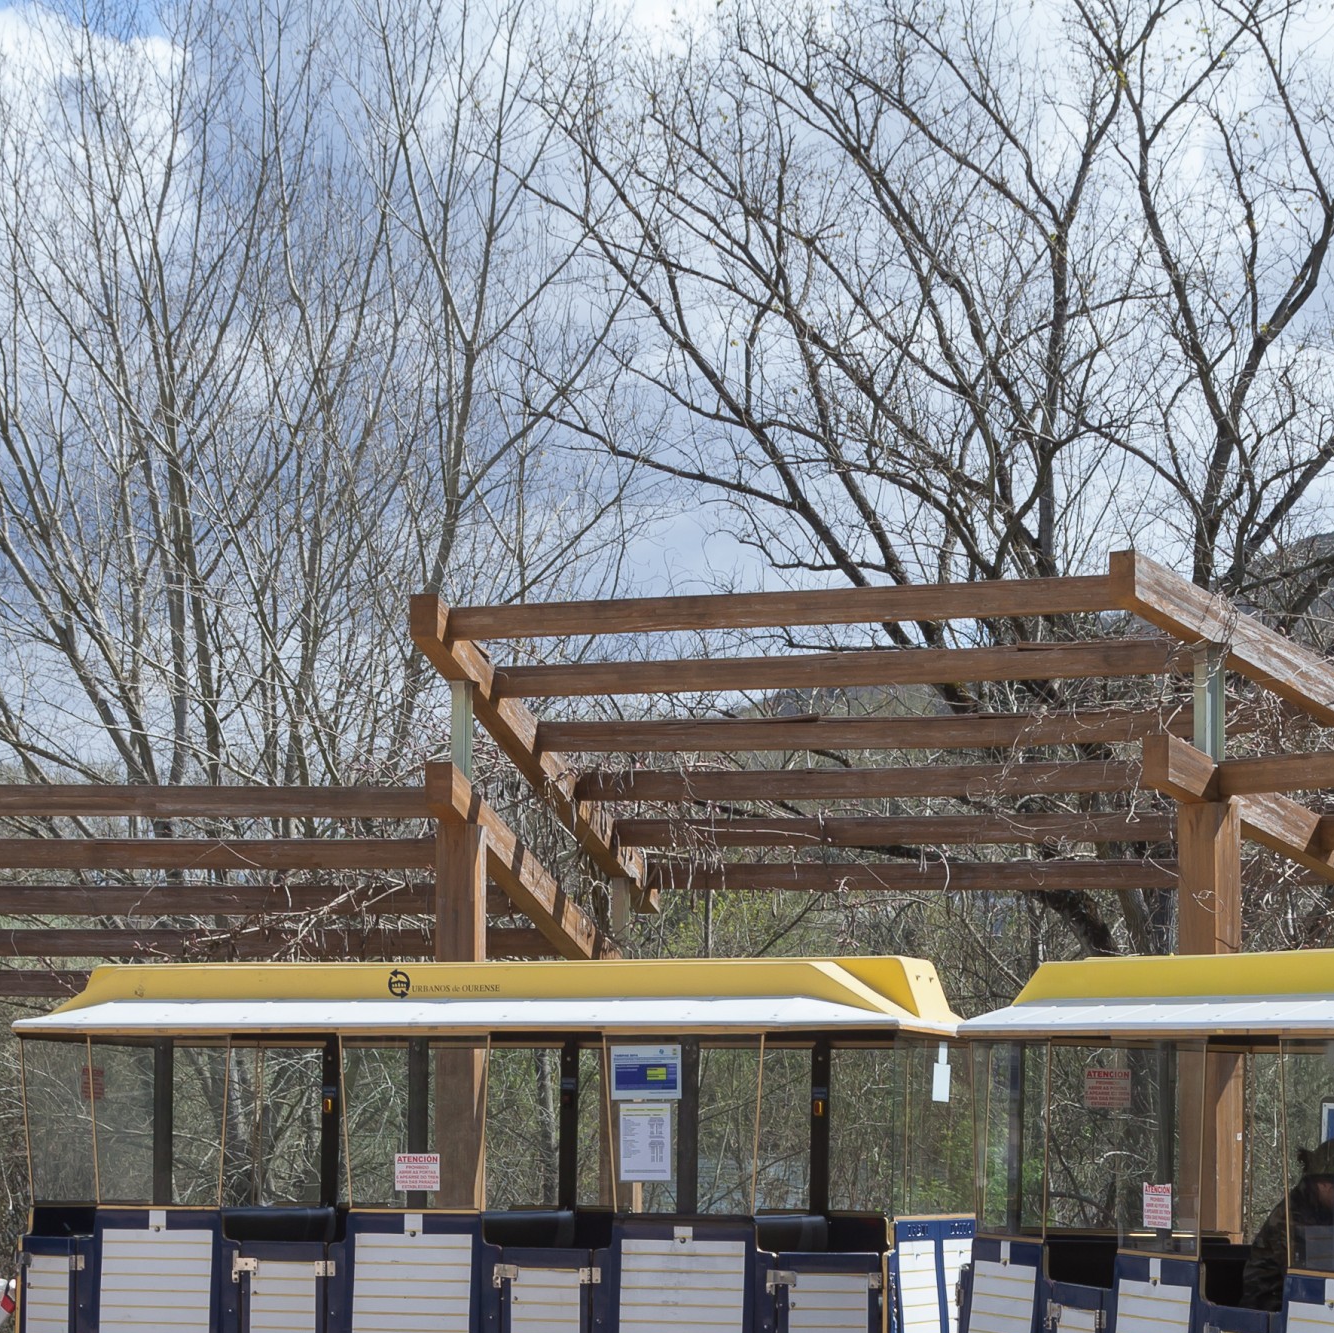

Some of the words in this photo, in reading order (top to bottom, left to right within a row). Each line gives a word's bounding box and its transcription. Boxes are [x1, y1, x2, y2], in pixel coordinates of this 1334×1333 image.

[411, 985, 451, 993] URBANOS
[452, 985, 461, 993] de
[461, 984, 501, 992] OURENSE
[397, 1155, 438, 1163] ATENCIÓN
